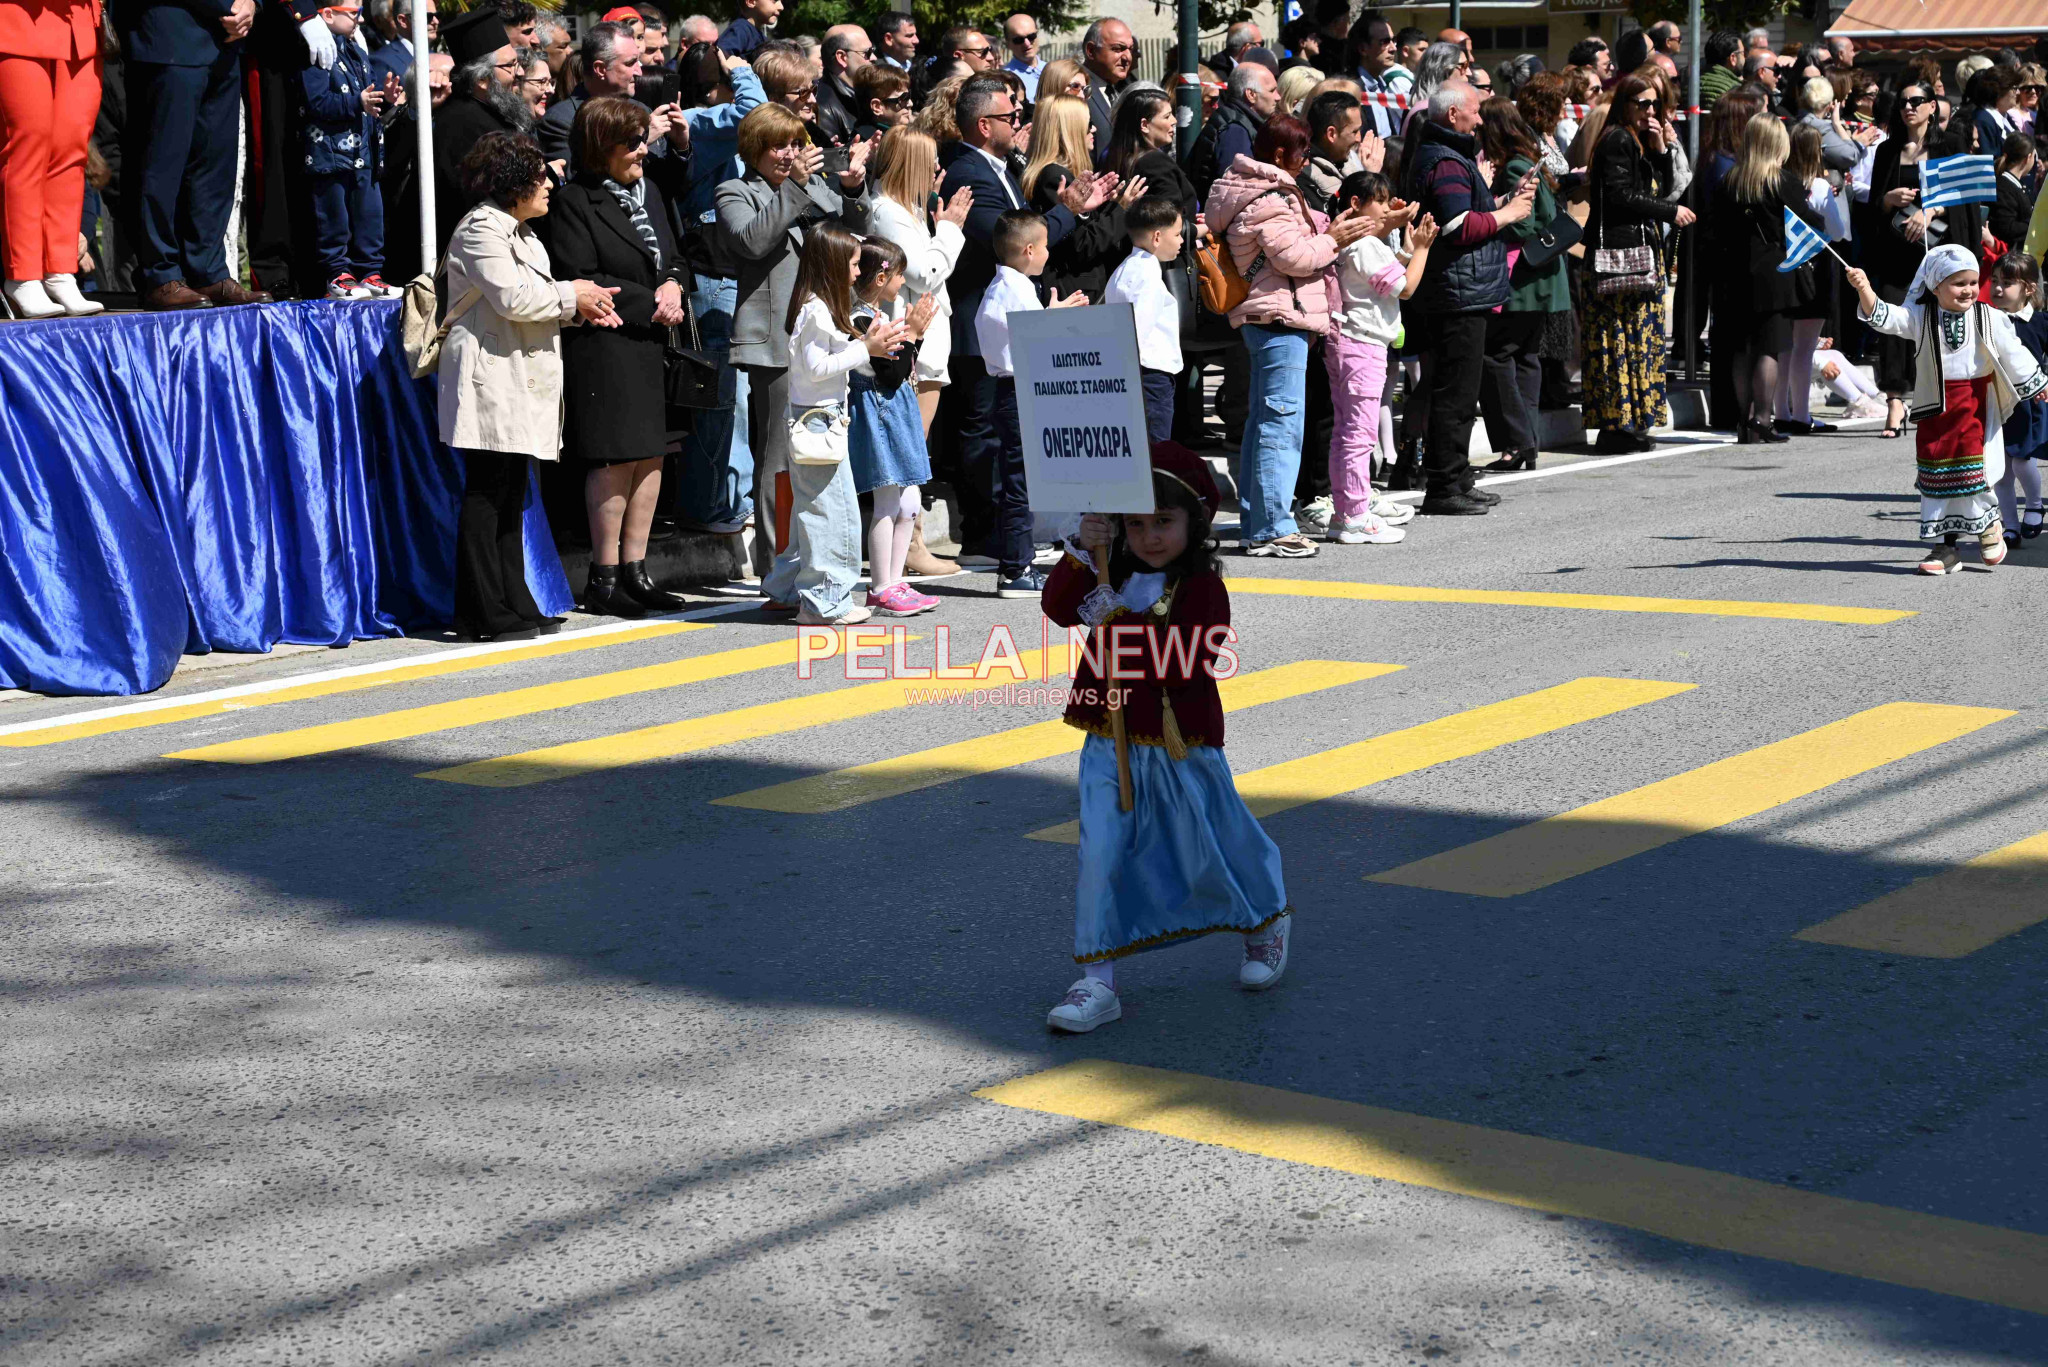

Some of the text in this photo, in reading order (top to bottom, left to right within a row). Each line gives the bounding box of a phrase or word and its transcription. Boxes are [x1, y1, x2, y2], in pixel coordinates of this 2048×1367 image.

[1052, 351, 1102, 368] ΙΔΙΩΤΙΚΟΣ
[1034, 378, 1127, 396] ΠΑΙΔΙΚΟΣ ΣΤΑΘΜΟΣ
[1042, 426, 1132, 458] ΟΝΕΙΡΟΧΩΡΑ
